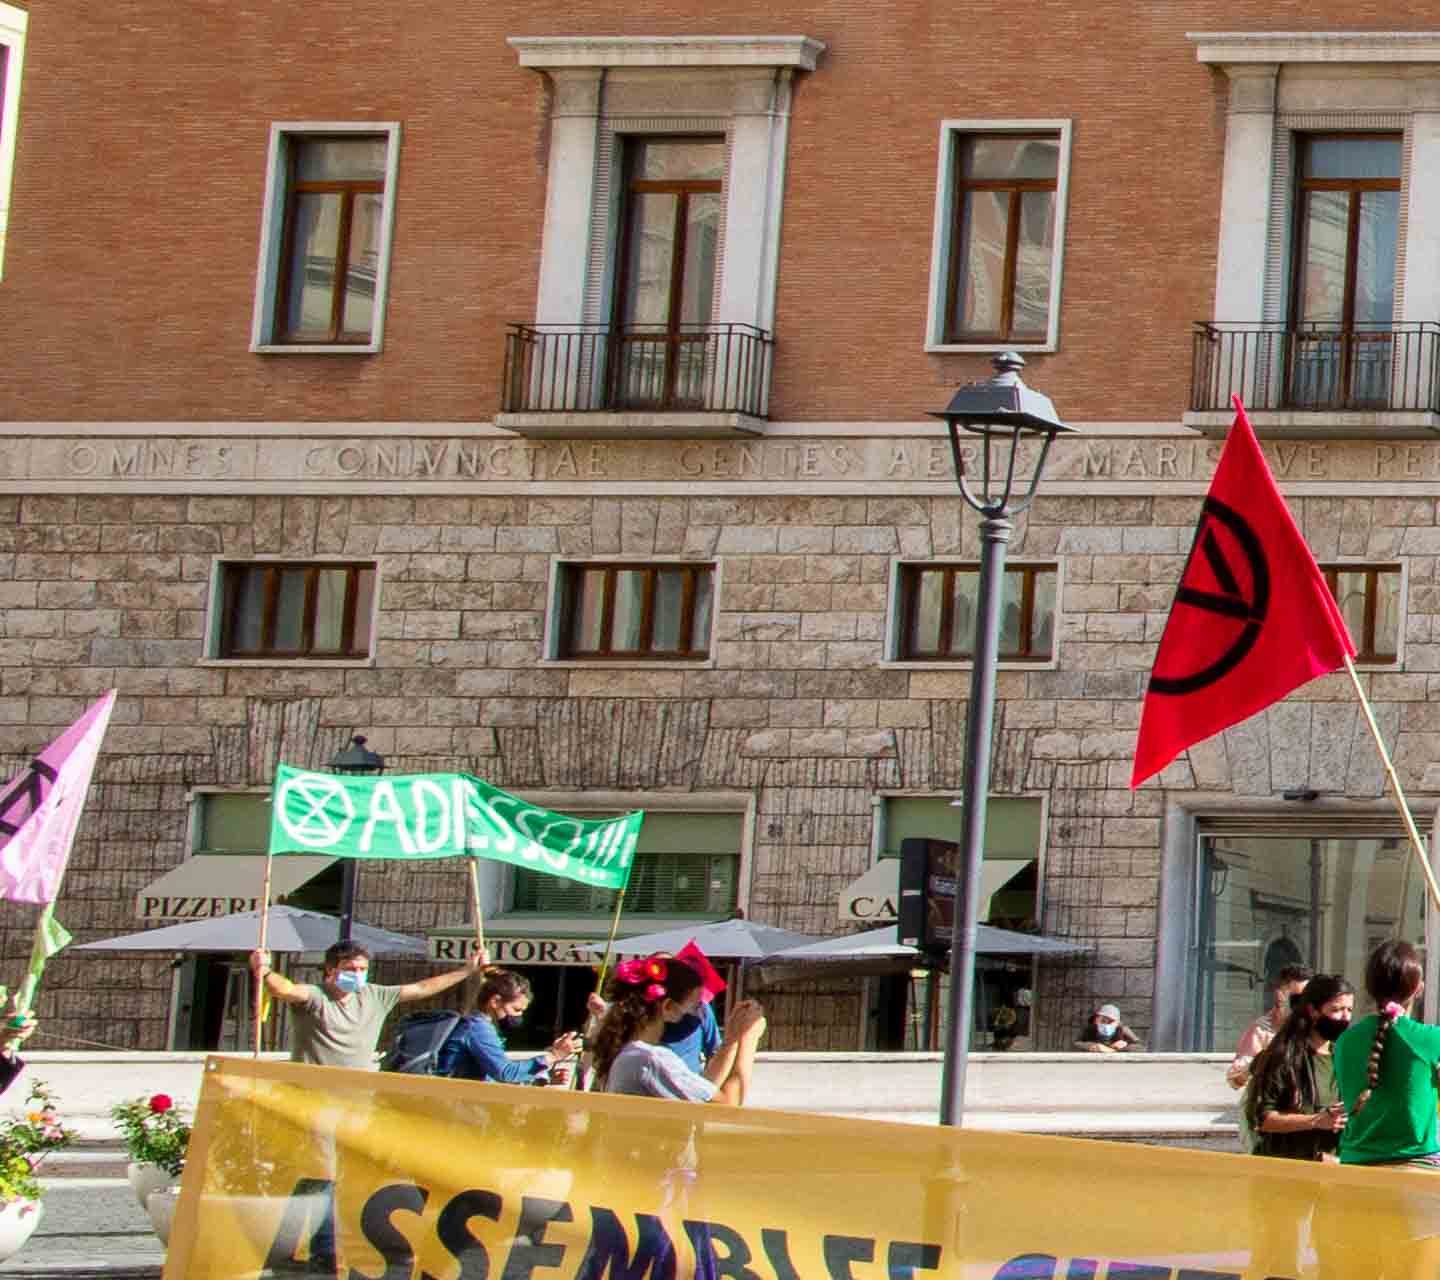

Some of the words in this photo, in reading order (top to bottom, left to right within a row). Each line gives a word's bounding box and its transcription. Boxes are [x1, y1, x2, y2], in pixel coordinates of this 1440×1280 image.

[679, 444, 850, 477] GENTES
[1081, 444, 1329, 478] MARISVE
[143, 896, 271, 918] PIZZERI
